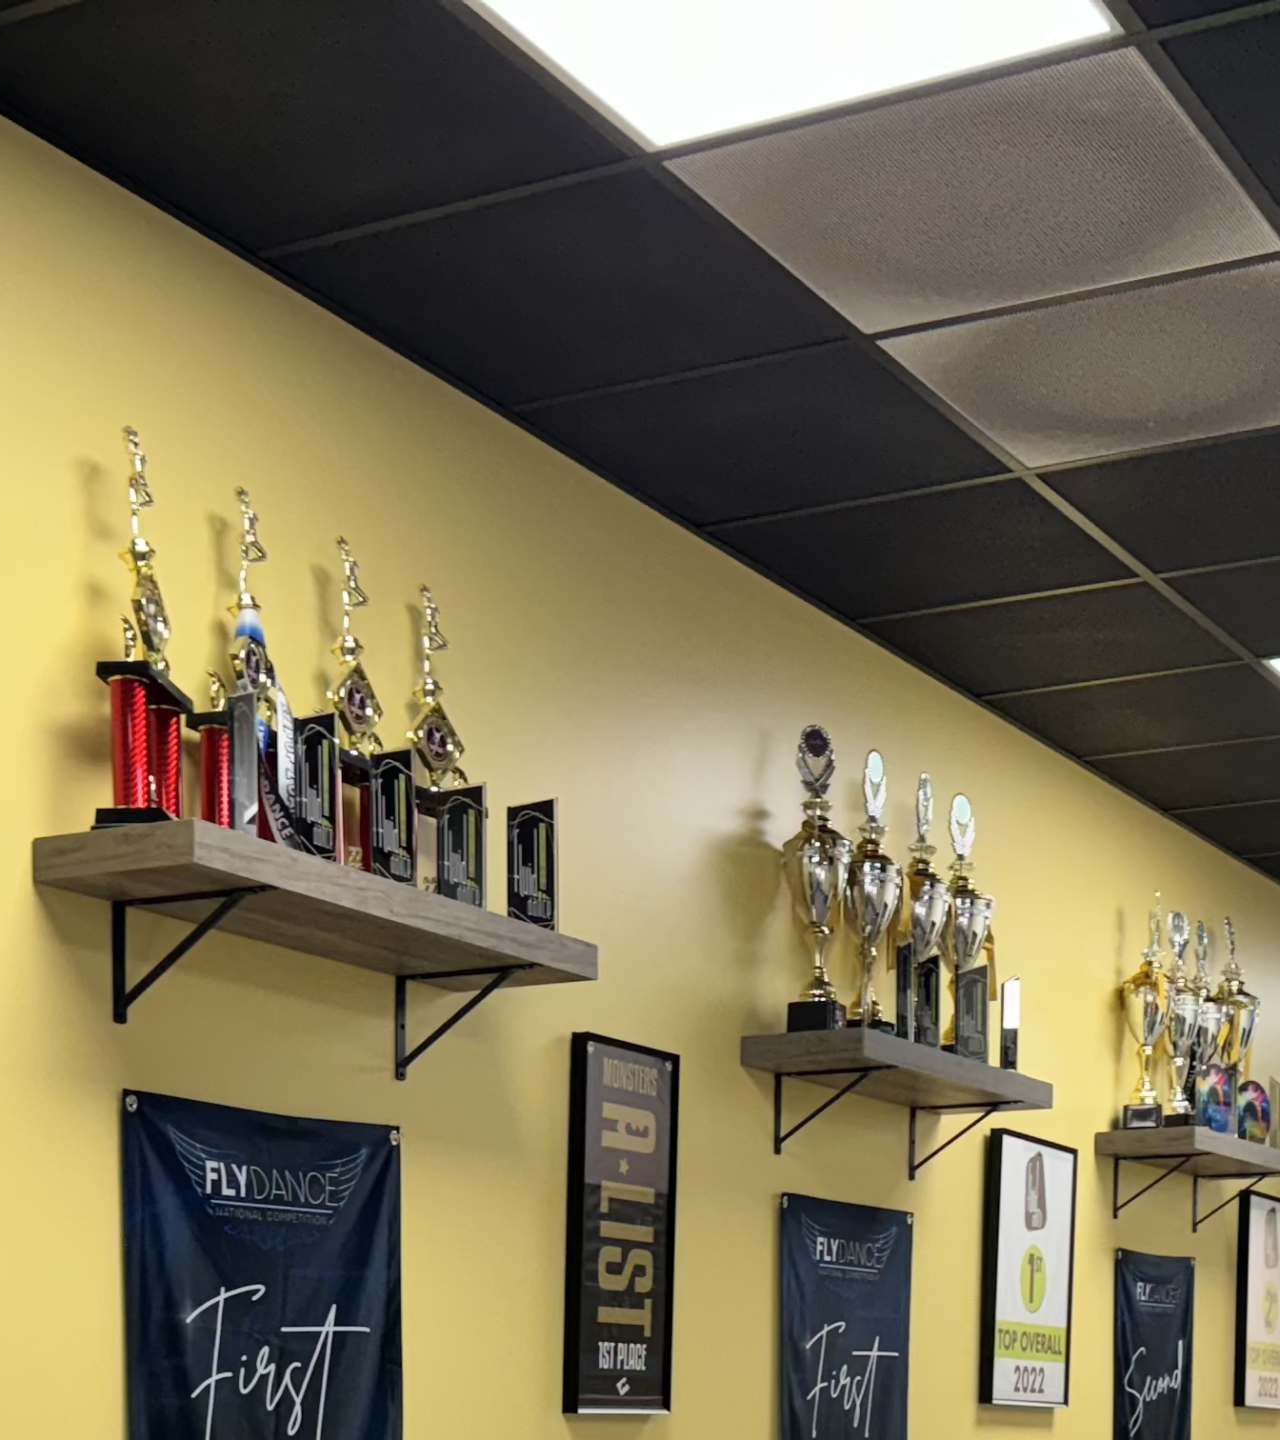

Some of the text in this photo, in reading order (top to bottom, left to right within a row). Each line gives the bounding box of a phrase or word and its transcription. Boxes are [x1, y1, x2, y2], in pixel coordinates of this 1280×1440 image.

[598, 1341, 647, 1371] 1ST PLACE
[997, 1327, 1063, 1356] TOP OVERALL
[806, 1320, 899, 1439] First
[1013, 1364, 1046, 1394] 2022
